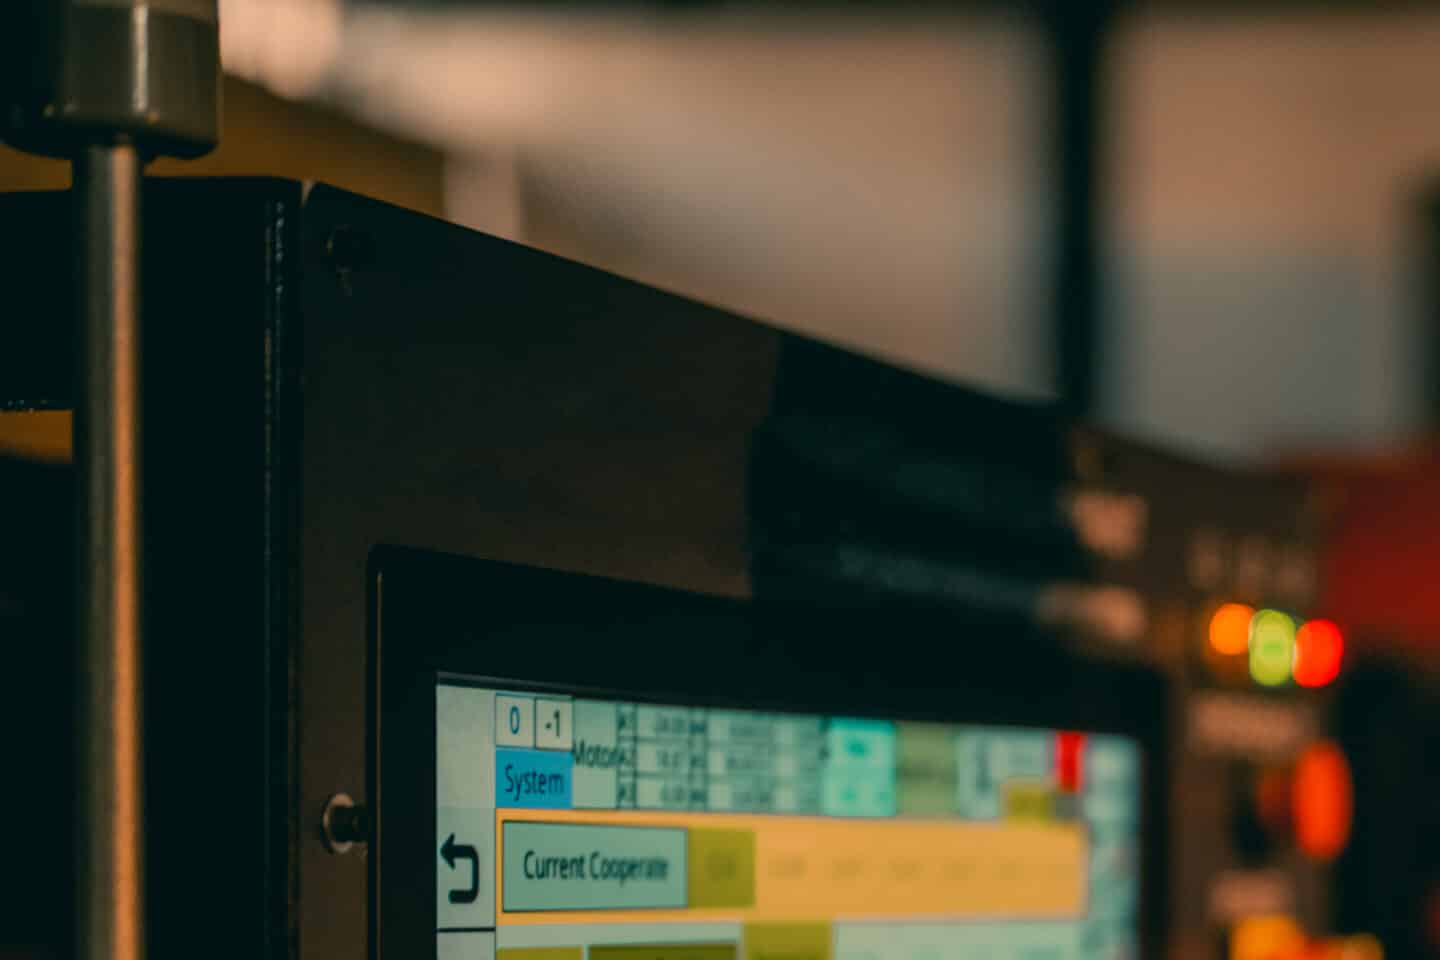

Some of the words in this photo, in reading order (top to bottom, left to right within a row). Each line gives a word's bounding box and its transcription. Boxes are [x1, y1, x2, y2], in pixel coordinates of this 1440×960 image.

[509, 705, 521, 735] 0
[545, 709, 561, 737] -1
[505, 764, 565, 800] System
[523, 850, 585, 881] Current
[589, 852, 669, 887] Cooperate
